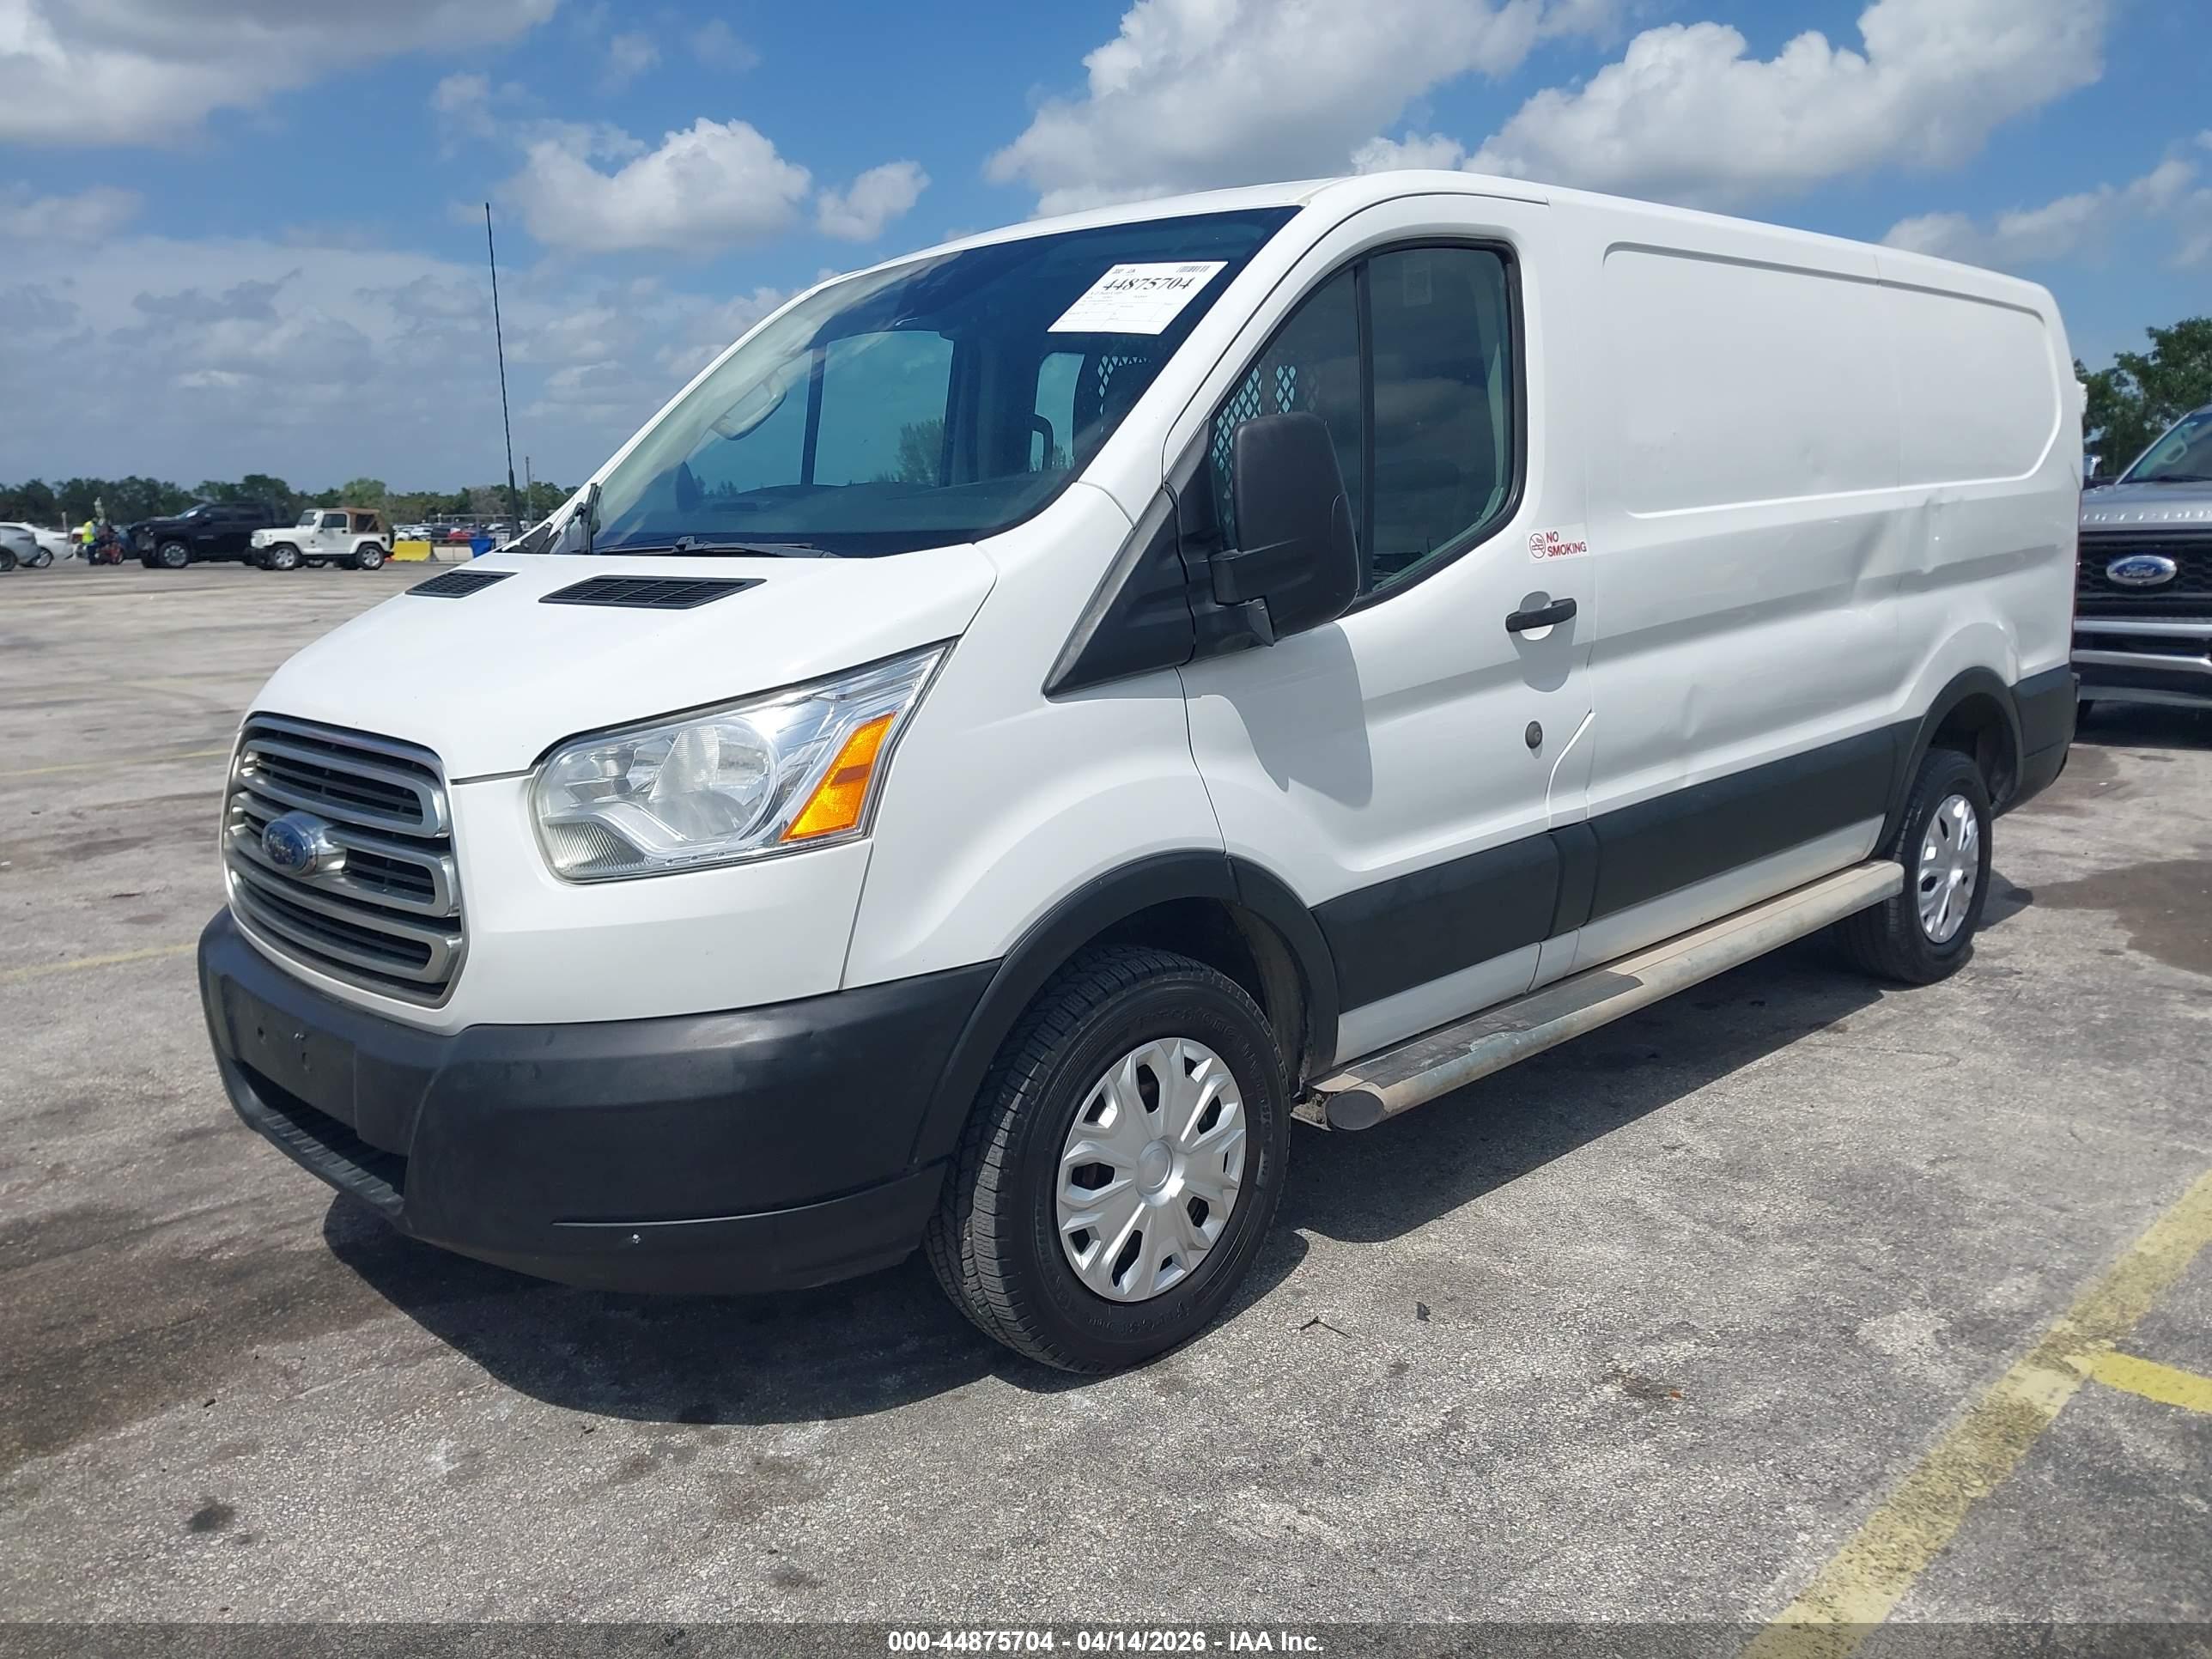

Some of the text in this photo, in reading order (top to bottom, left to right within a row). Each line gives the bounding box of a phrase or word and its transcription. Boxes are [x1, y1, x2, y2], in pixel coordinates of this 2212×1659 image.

[1103, 276, 1195, 291] 44875704
[1546, 531, 1559, 544] NO
[1547, 541, 1587, 557] SMOKING
